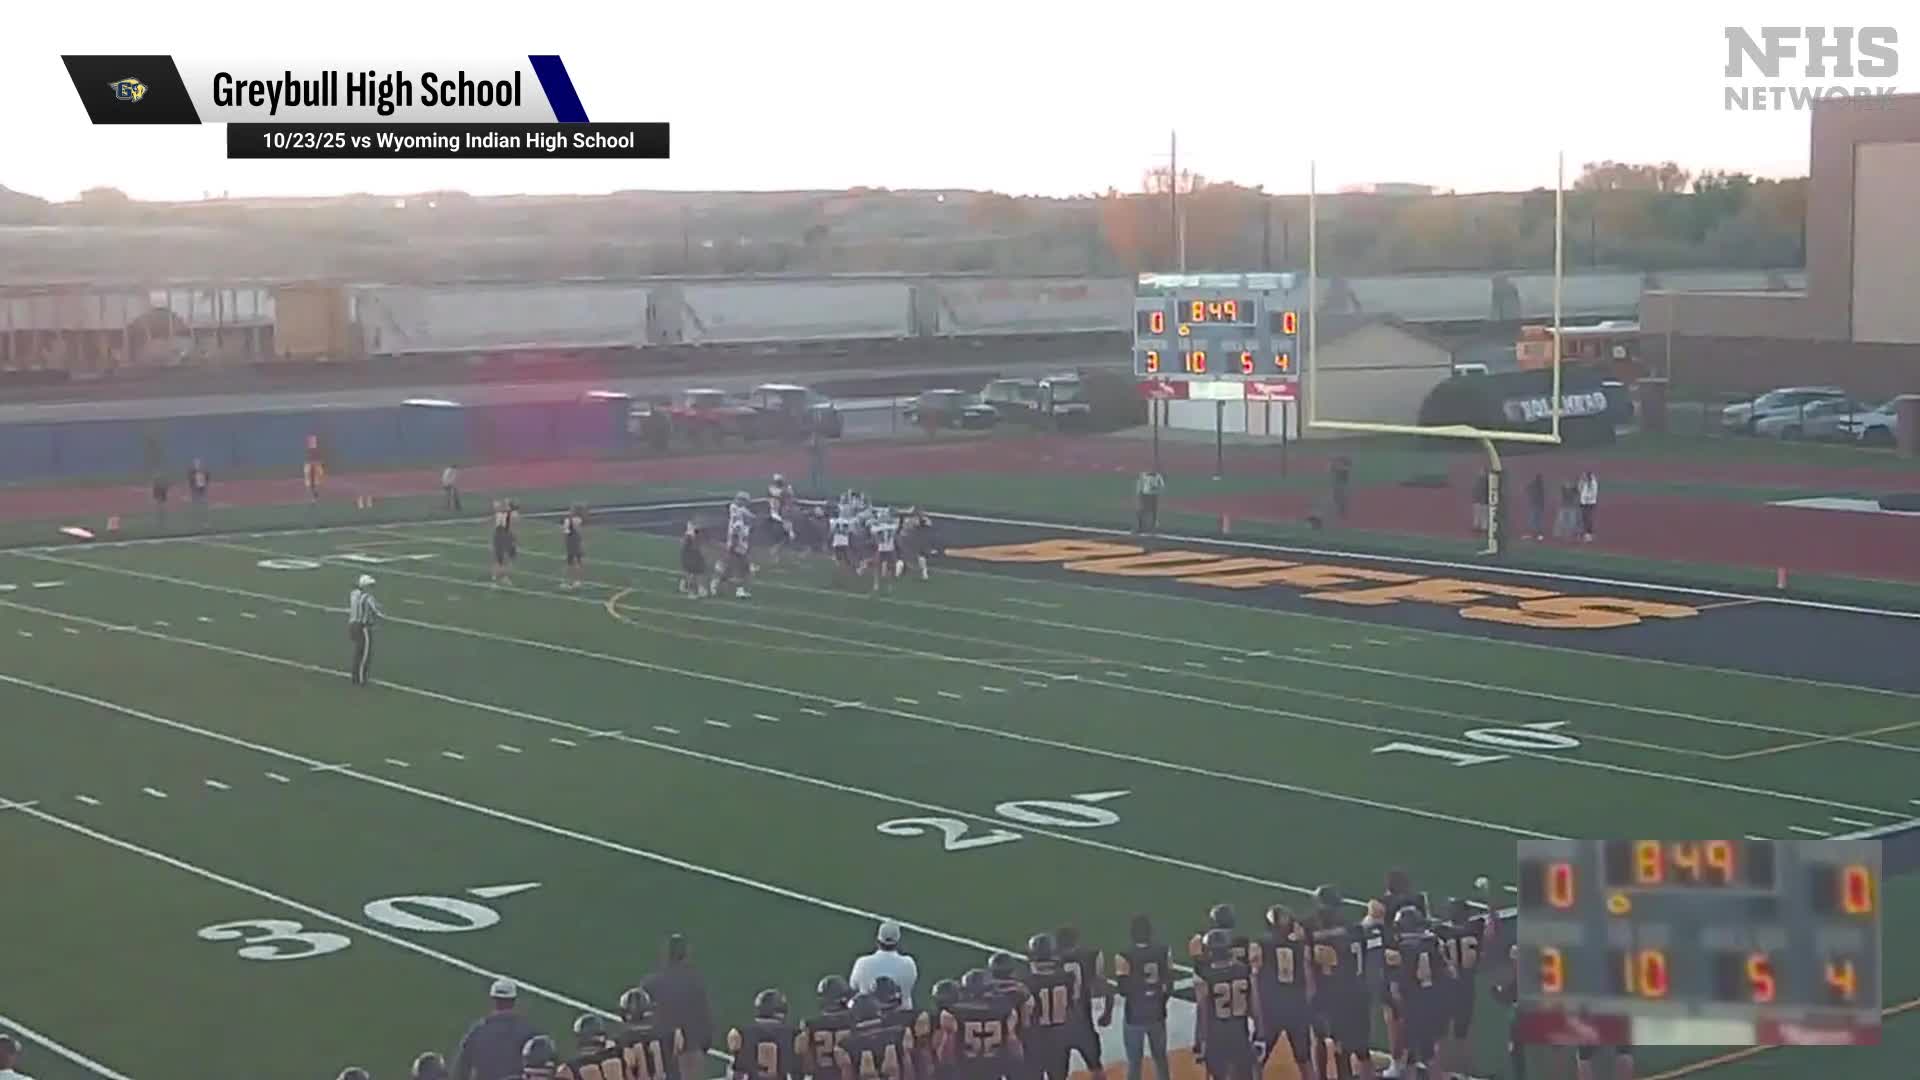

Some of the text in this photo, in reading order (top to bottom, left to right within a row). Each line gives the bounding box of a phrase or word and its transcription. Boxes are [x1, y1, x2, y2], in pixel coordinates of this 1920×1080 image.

[1150, 311, 1164, 333] 0
[1282, 311, 1297, 335] 0
[1146, 351, 1160, 373] 3
[1185, 351, 1207, 373] 10
[1240, 351, 1254, 374] 5
[1274, 352, 1289, 373] 4
[944, 539, 1699, 629] BUFFS
[1371, 723, 1582, 768] 10
[876, 798, 1122, 852] 20
[197, 893, 501, 961] 30
[964, 1020, 1003, 1058] 52
